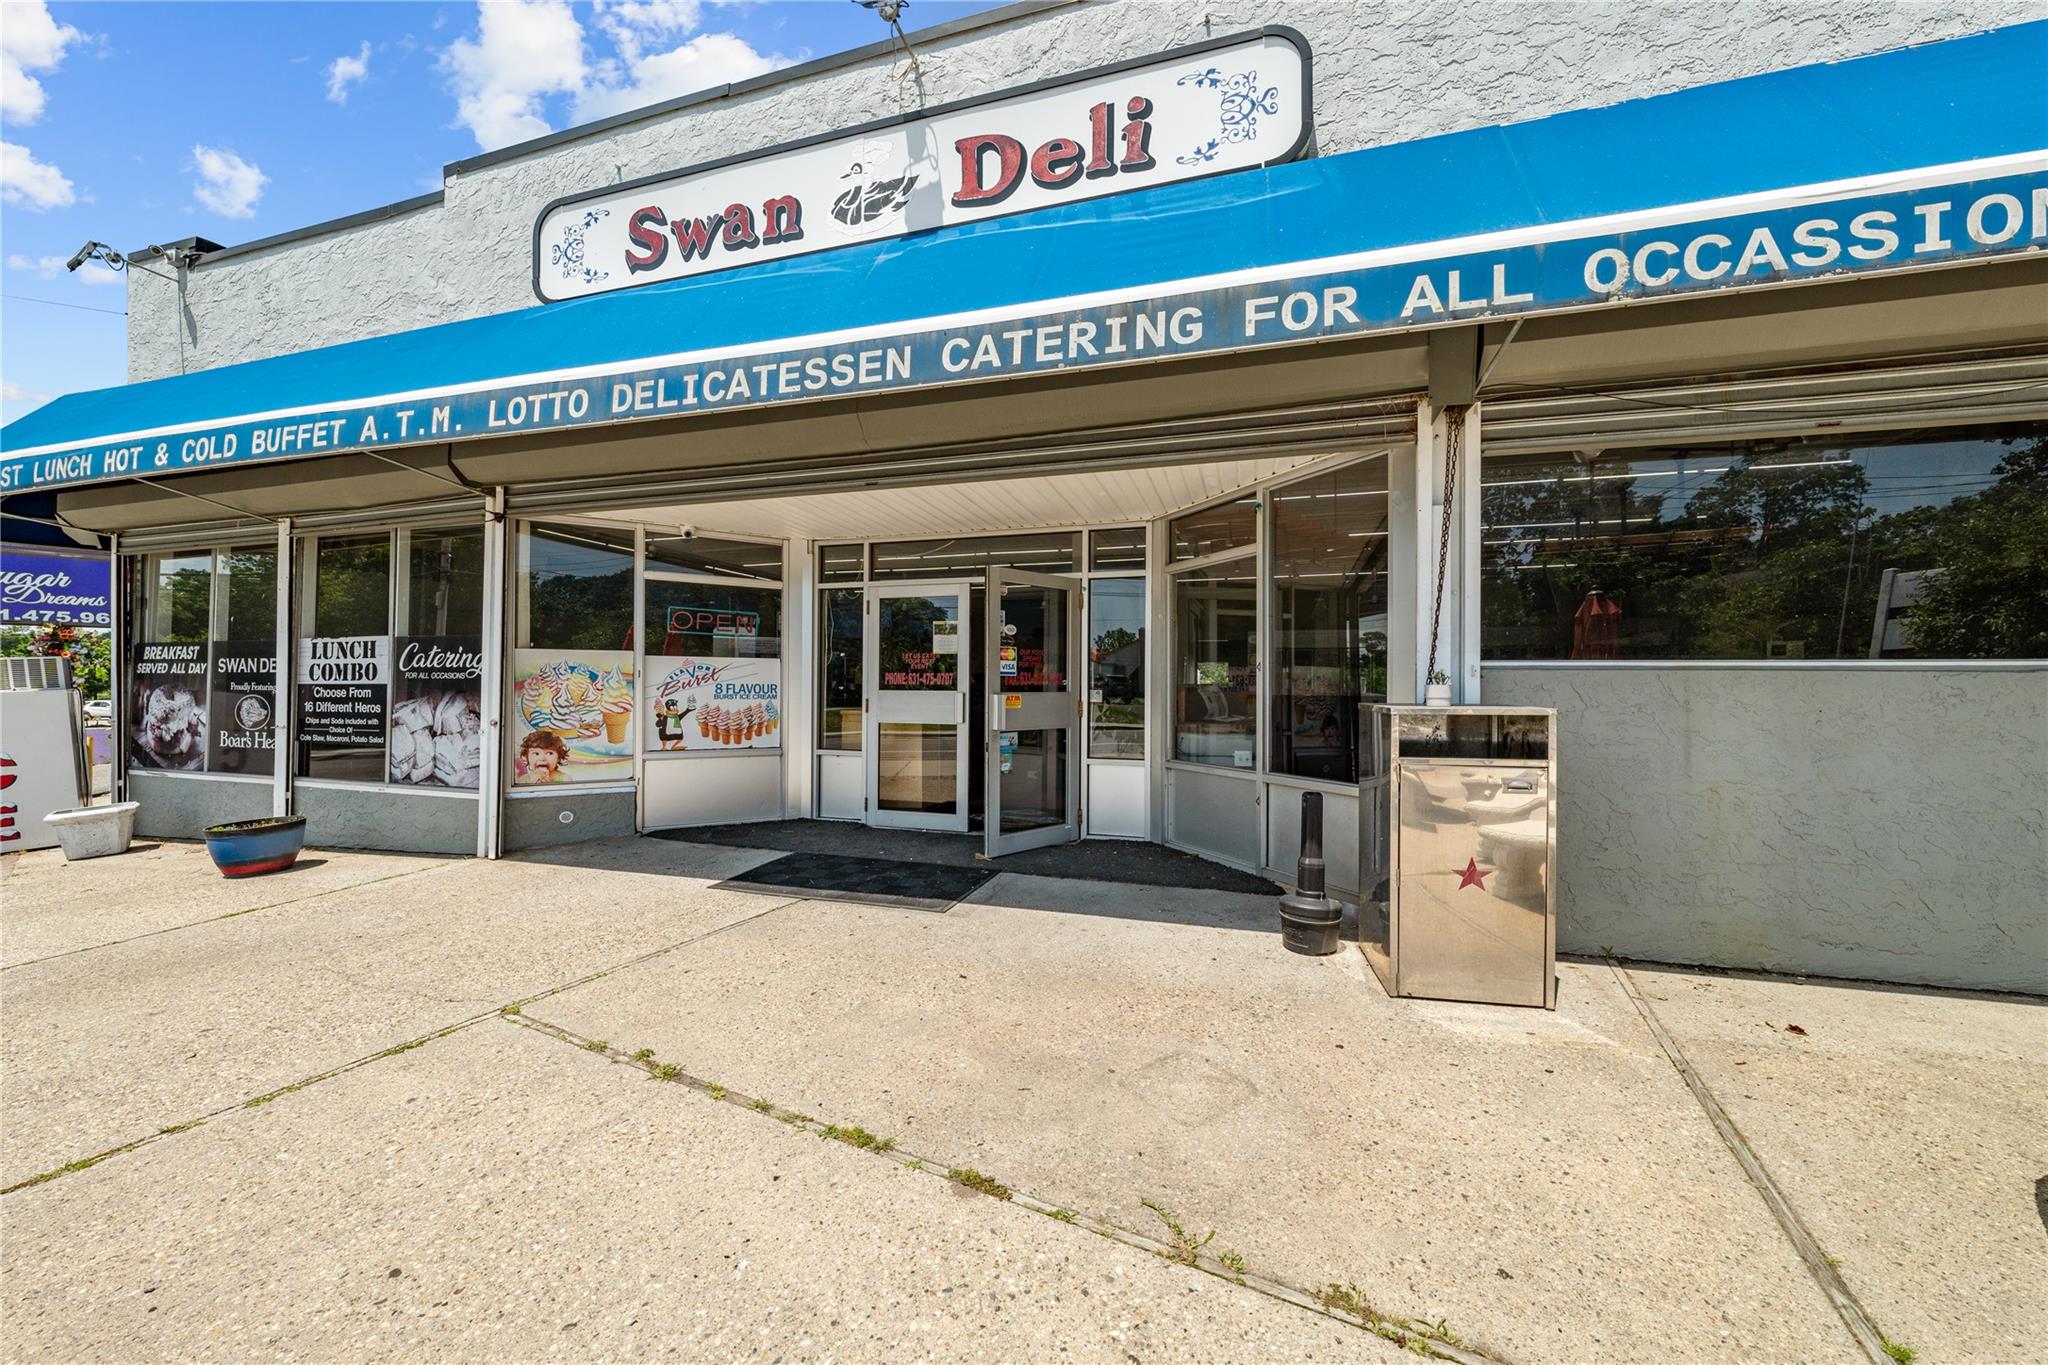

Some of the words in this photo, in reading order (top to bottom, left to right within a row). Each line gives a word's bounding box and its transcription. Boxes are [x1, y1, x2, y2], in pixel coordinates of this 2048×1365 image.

[624, 194, 804, 276] Swan
[951, 96, 1157, 208] Deli
[33, 453, 93, 483] LUNCH
[103, 446, 142, 473] HOT
[154, 443, 169, 466] &
[181, 432, 238, 462] COLD
[252, 418, 347, 454] BUFFET
[359, 406, 463, 441] A.T.M.
[487, 388, 589, 428] LOTTO
[611, 345, 912, 414] DELICATESSEN
[942, 306, 1204, 373] CATERING
[1245, 285, 1360, 337] FOR
[1401, 263, 1534, 318] ALL
[0, 570, 71, 595] ugar
[2, 586, 107, 607] Dreams
[672, 610, 756, 633] OPEN
[143, 646, 200, 660] BREAKFAST
[310, 640, 377, 660] LUNCH
[136, 663, 168, 674] SERVED
[170, 663, 186, 674] ALL
[188, 663, 207, 674] DAY
[218, 658, 257, 673] SWAN
[259, 659, 277, 673] DE
[398, 642, 482, 679] Catering
[308, 662, 378, 682] COMBO
[404, 671, 418, 679] FOR
[418, 671, 430, 679] ALL
[669, 664, 711, 680] FLAVOR
[230, 682, 251, 693] Proudly
[656, 663, 734, 698] Burst
[313, 686, 347, 698] Choose
[349, 687, 372, 698] From
[714, 683, 723, 694] 8
[725, 683, 778, 695] FLAVOUR
[303, 701, 314, 712] 16
[315, 701, 353, 713] Different
[354, 702, 381, 714] Heros
[305, 716, 320, 726] Chips
[320, 717, 330, 725] and
[330, 717, 345, 725] Soda
[367, 717, 379, 725] with
[219, 730, 252, 748] Boar's
[254, 732, 276, 749] Hea
[299, 734, 312, 742] Cole
[351, 735, 368, 743] Potato
[368, 736, 384, 744] Salad
